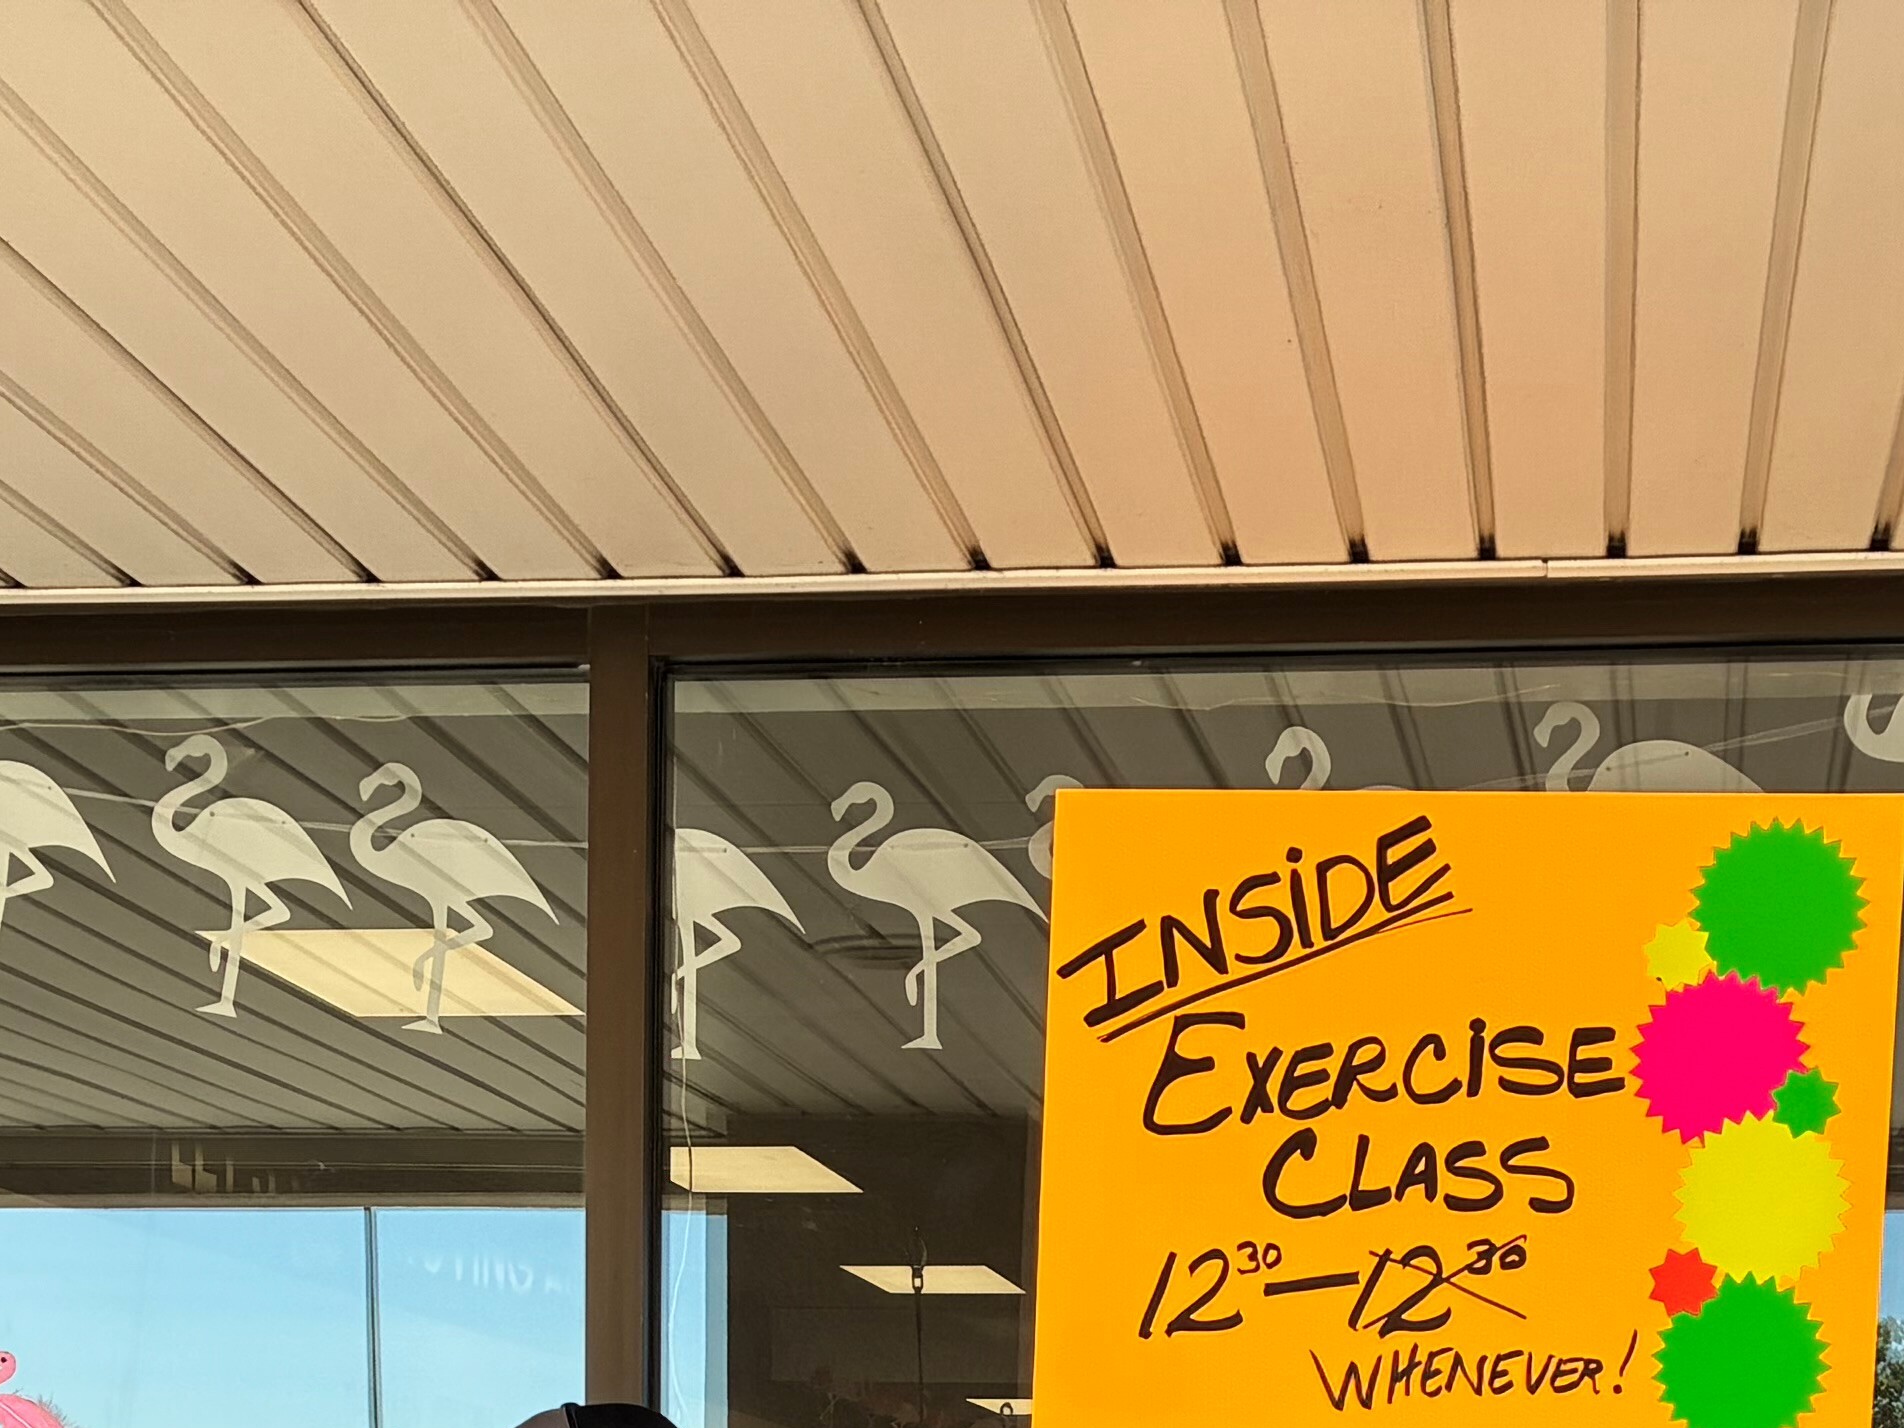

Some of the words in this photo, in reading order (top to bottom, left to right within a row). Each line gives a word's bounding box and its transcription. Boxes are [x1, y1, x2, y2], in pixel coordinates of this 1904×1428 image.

[1057, 815, 1454, 1028] INSIDE
[1142, 1013, 1627, 1136] EXERCISE
[1262, 1128, 1576, 1219] CLASS
[1308, 1329, 1639, 1413] WHENEVER!
